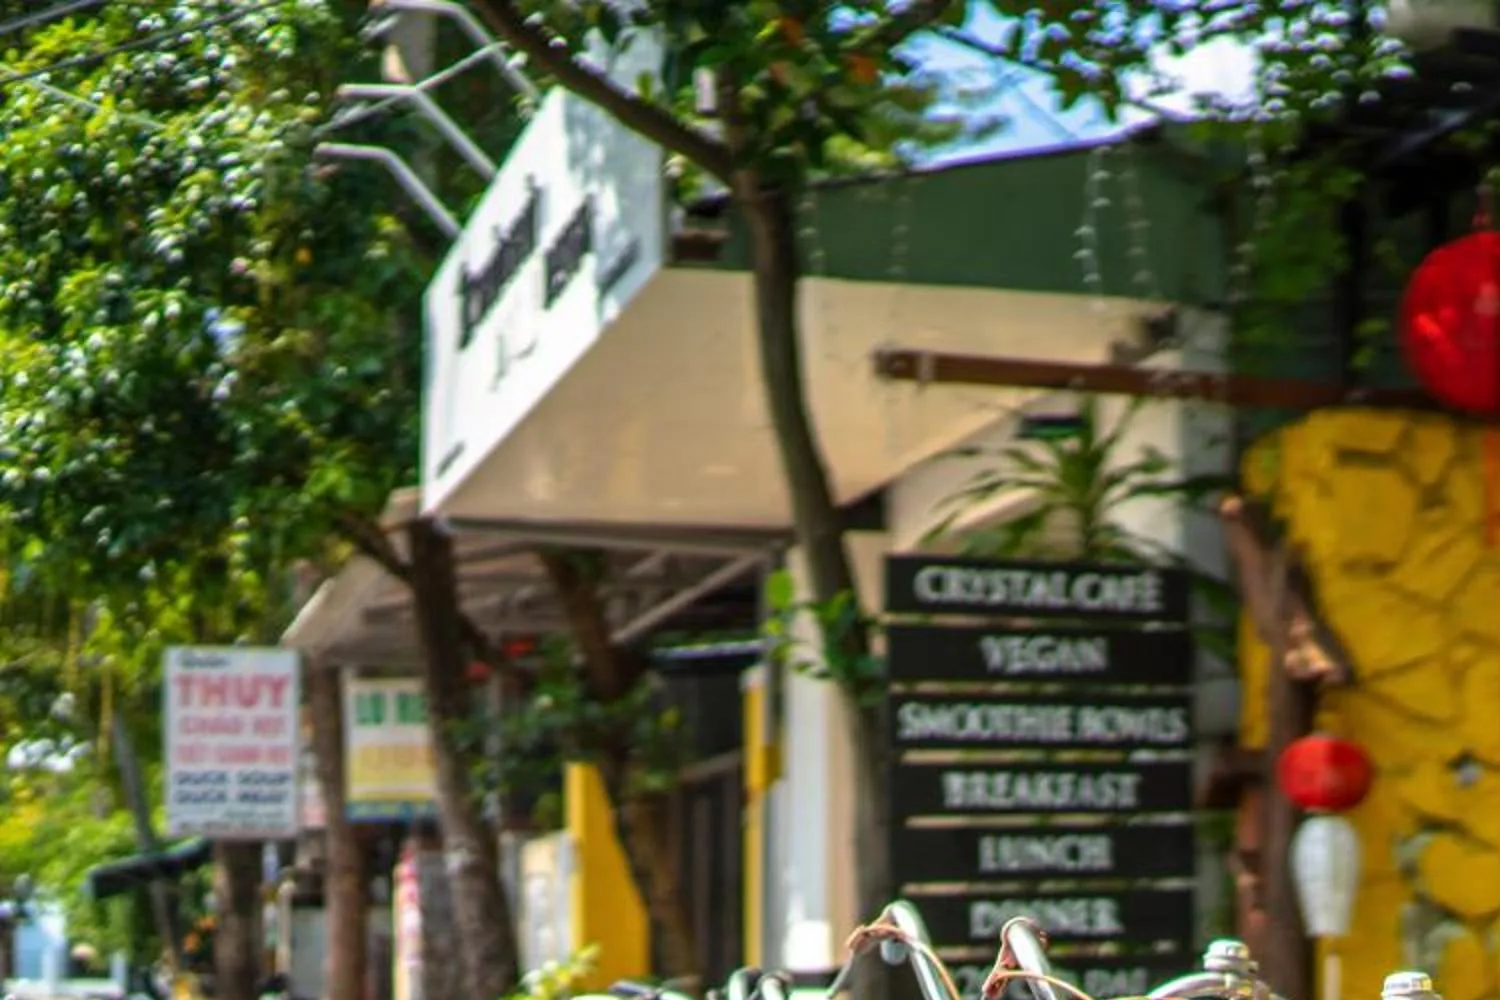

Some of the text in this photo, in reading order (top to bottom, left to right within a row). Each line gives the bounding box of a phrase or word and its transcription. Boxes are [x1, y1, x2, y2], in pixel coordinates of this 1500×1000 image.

[914, 566, 1068, 606] CRYSTAL
[979, 635, 1108, 673] VEGAN
[897, 701, 1187, 743] SMOOTHIE BOWLS
[941, 771, 1142, 809] BREAKFAST
[978, 834, 1114, 872] LUNCH
